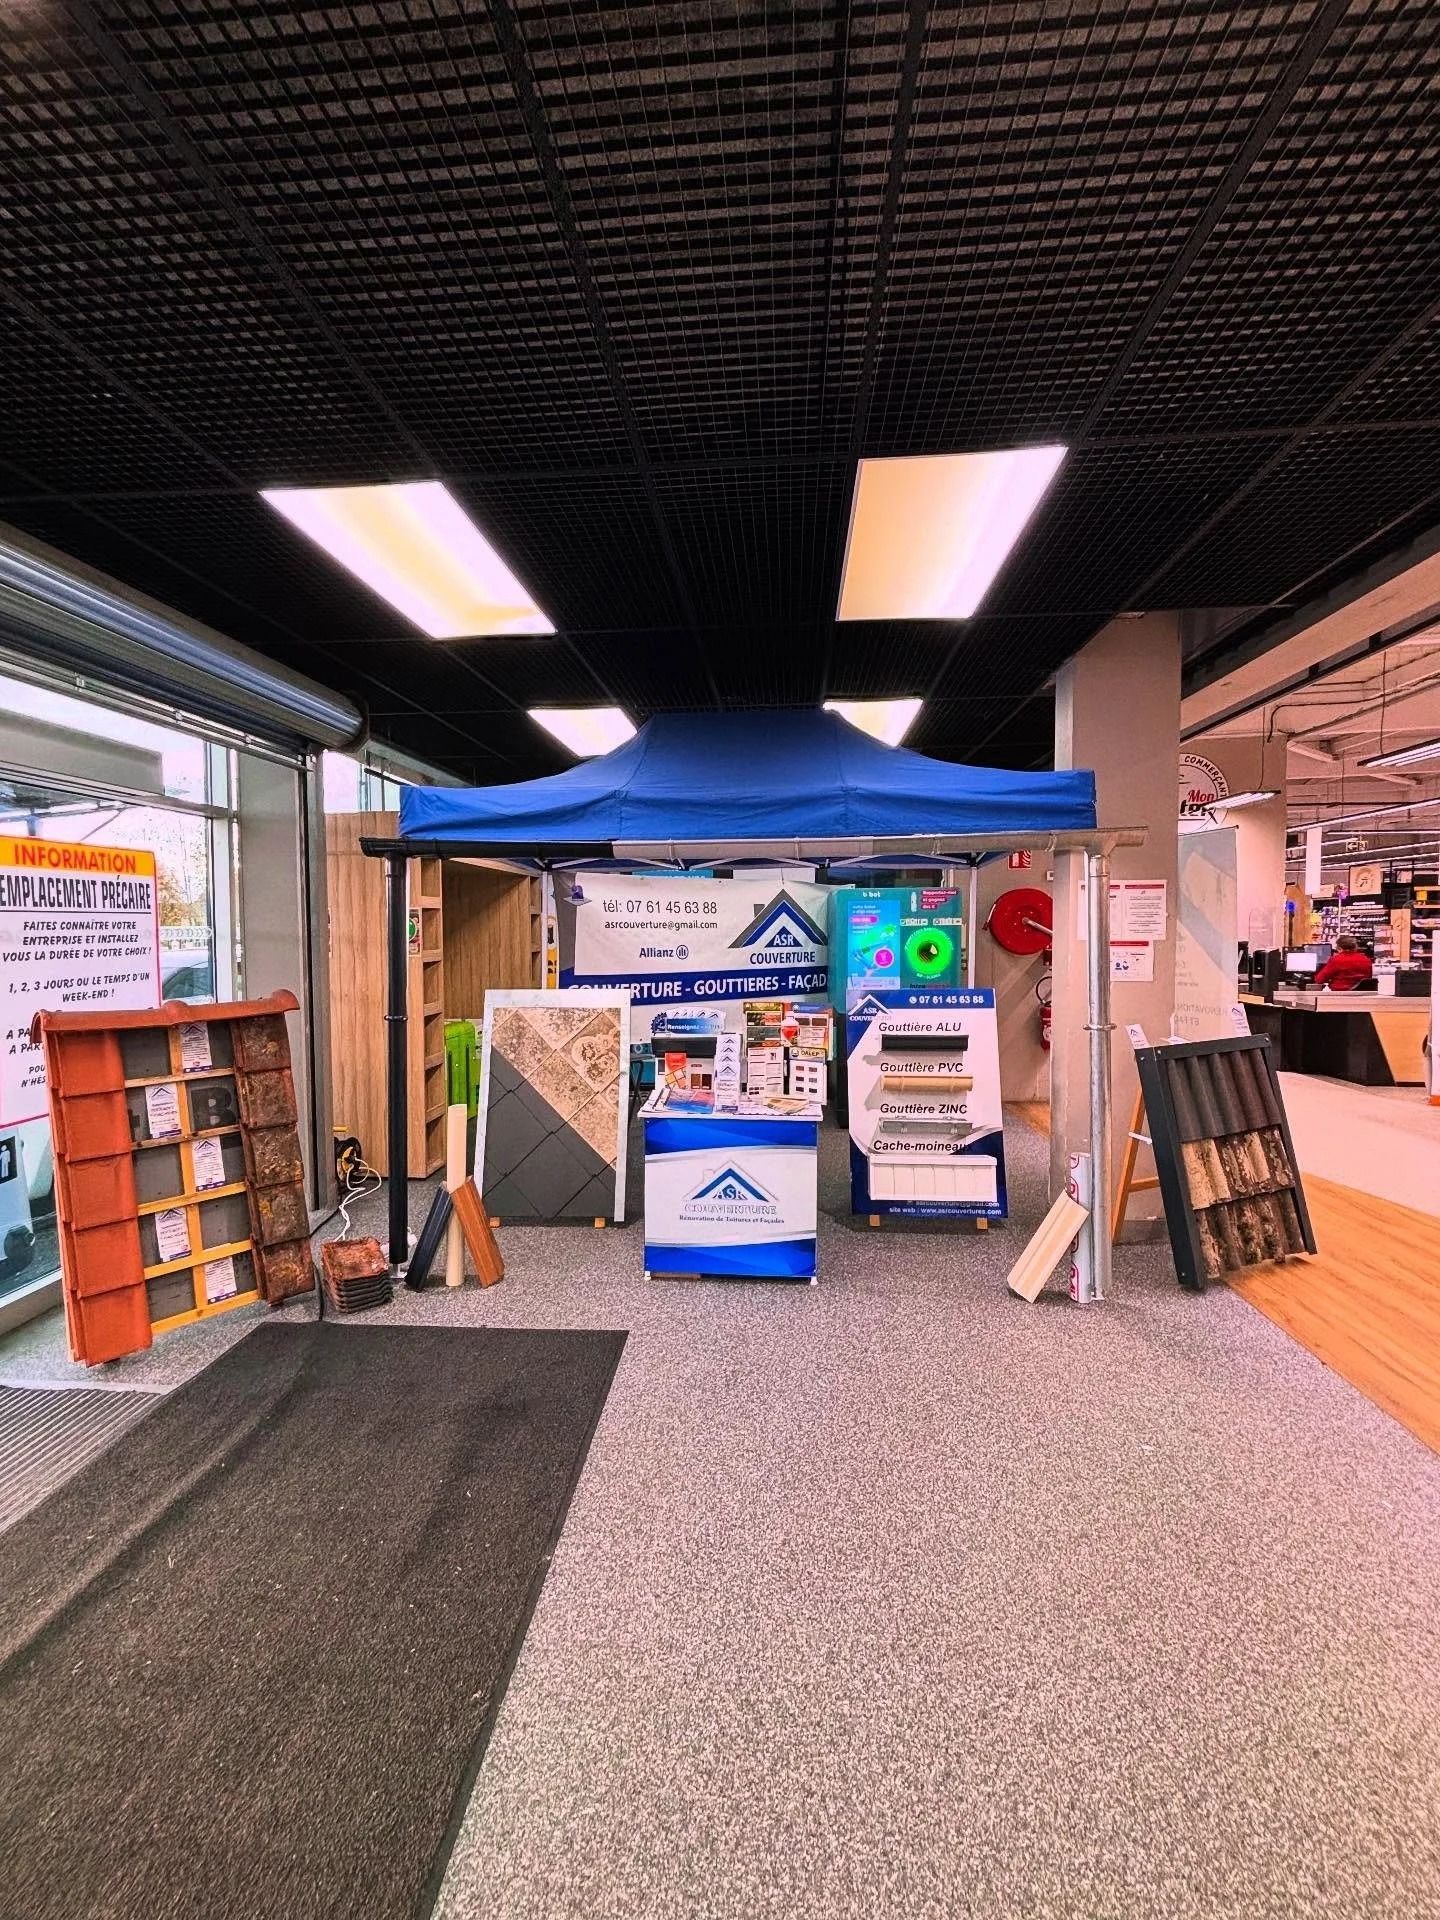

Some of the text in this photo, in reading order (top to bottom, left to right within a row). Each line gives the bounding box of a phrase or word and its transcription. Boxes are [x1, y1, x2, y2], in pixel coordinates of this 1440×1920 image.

[1188, 790, 1214, 802] Mon
[14, 843, 136, 874] INFORMATION
[0, 875, 151, 910] EMPLACEMENT PRÉCAIRE
[603, 900, 718, 914] tél: 07 61 45 63 88
[24, 918, 136, 931] FAITES CONNAÎTRE VOTRE
[604, 920, 718, 932] asrcouverture@gmail.com
[22, 934, 139, 946] ENTREPRISE ET INSTALLEZ
[773, 934, 794, 946] ASR
[2, 951, 31, 962] VOUS
[34, 951, 46, 960] LA
[50, 948, 80, 960] DURÉE
[83, 949, 94, 958] DE
[98, 948, 122, 958] VOTRE
[124, 947, 147, 956] CHOIX
[640, 947, 674, 958] Allianz
[750, 951, 816, 964] COUVERTURE
[8, 972, 150, 994] 1, 2, 3 JOURS OU LE TEMPS D'UN
[694, 976, 778, 995] GOUTTIERES
[62, 990, 109, 1002] WEEK-END
[919, 996, 984, 1004] 07 61 45 63 88
[878, 1022, 962, 1032] Gouttière ALU
[6, 1027, 32, 1040] A PA
[9, 1042, 44, 1054] A PAR
[880, 1062, 964, 1073] Gouttière PVC
[880, 1104, 968, 1114] Gouttière ZINC
